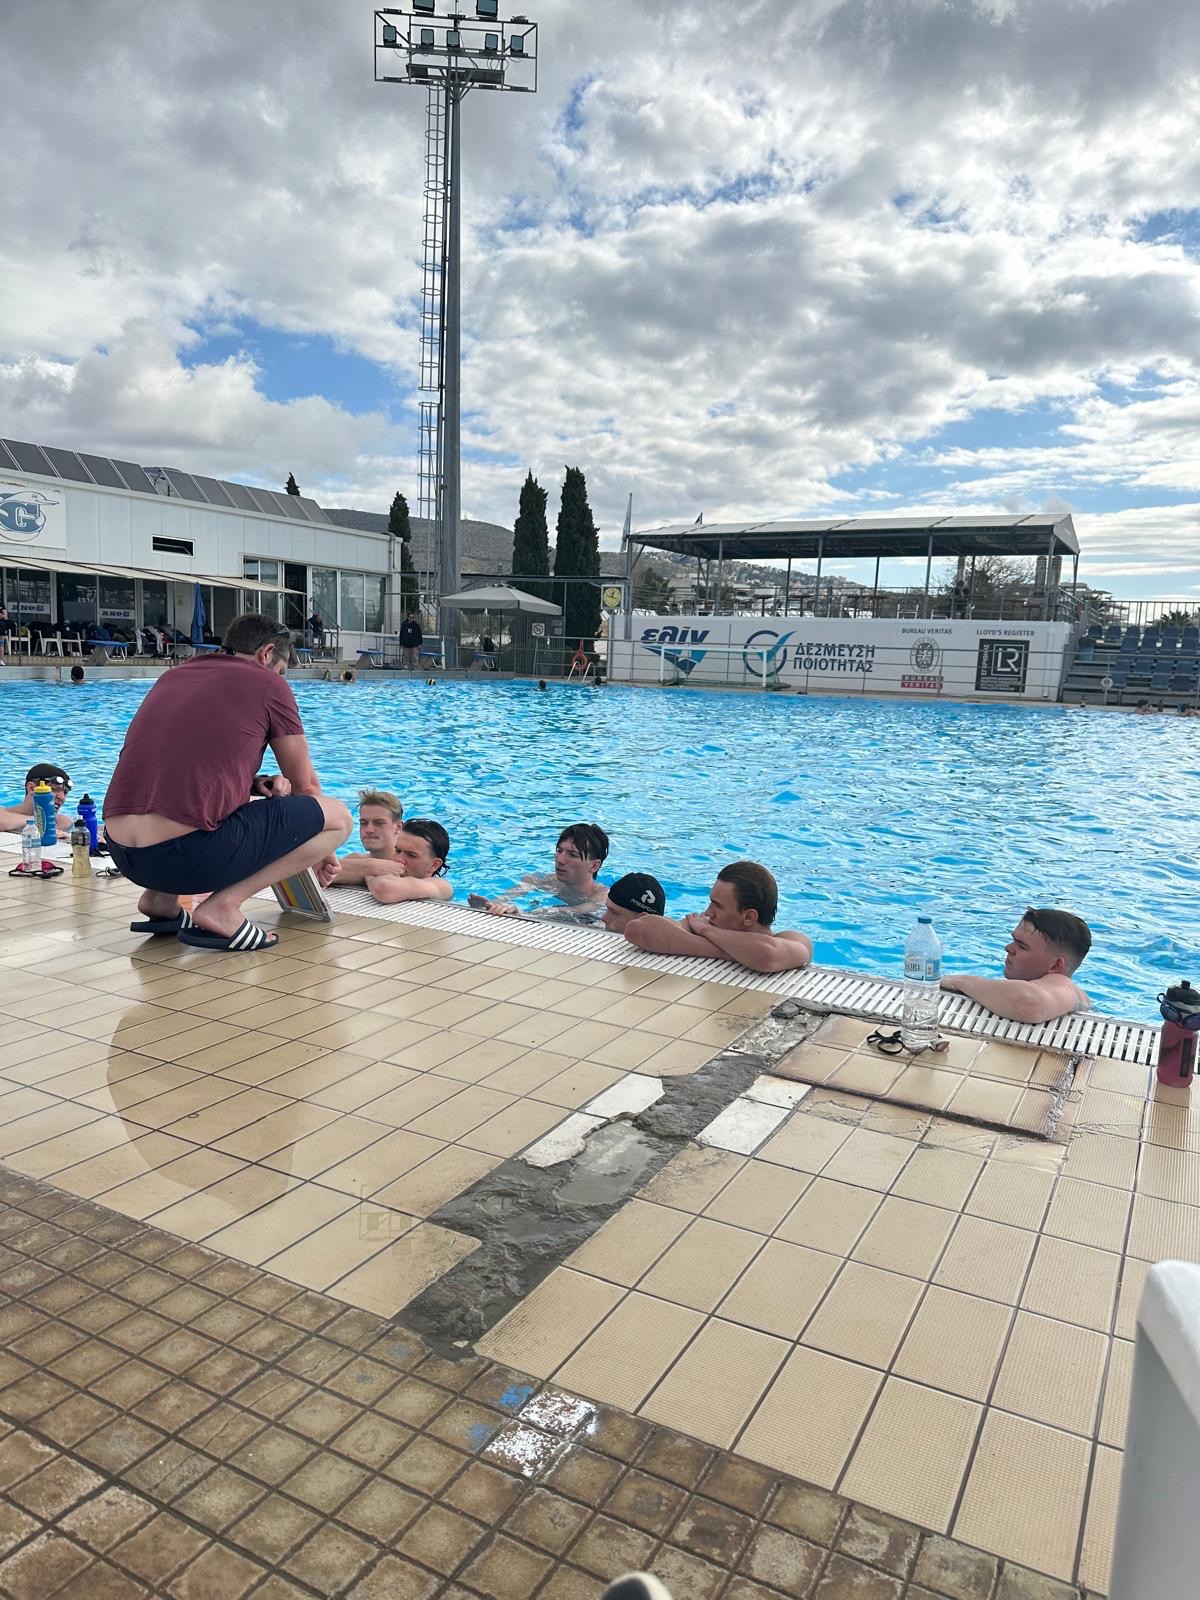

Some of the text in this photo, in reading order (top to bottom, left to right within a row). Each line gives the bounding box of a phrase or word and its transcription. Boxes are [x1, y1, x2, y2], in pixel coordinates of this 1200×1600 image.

[795, 642, 876, 658] ΔΕΣΜΕΥΣΗ
[793, 657, 874, 672] ΠΟΙΟΤΗΤΑΣ
[996, 648, 1019, 672] LR
